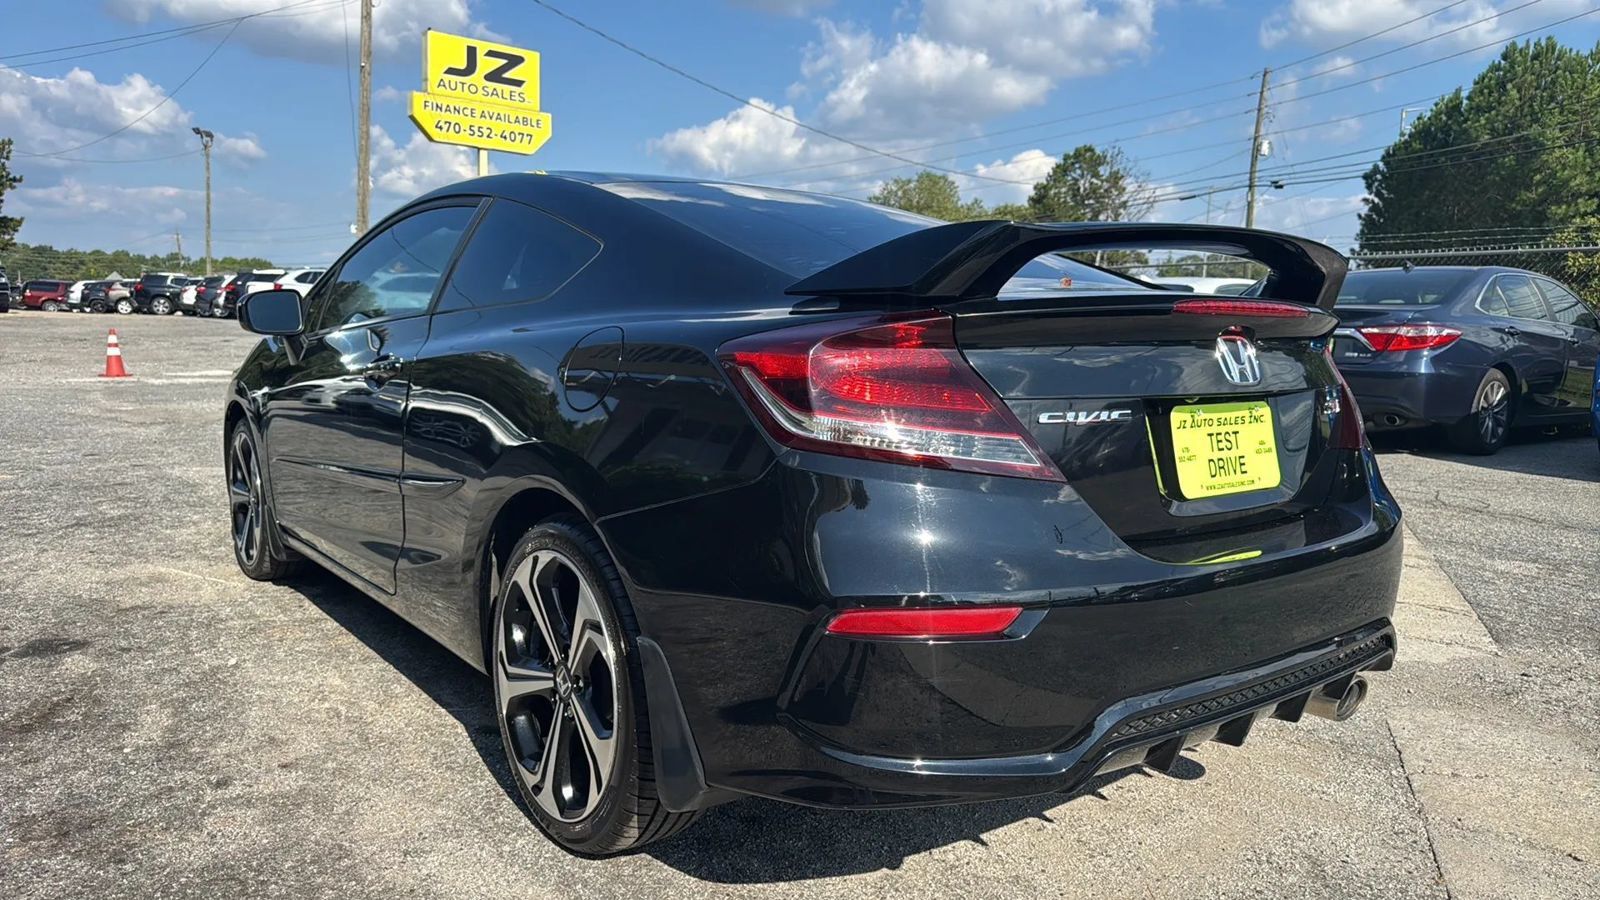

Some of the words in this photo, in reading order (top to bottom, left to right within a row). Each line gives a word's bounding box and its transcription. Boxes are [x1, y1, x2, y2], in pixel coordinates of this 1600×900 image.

[443, 45, 526, 88] JZ
[437, 78, 478, 95] AUTO
[482, 86, 526, 103] SALES
[423, 100, 476, 118] FINANCE
[480, 110, 542, 129] AVAILABLE
[435, 119, 533, 145] 470-552-4077
[1038, 409, 1132, 426] CIVIC
[1177, 420, 1187, 430] JZ
[1190, 417, 1214, 429] AUTO
[1217, 415, 1246, 427] SALES
[1207, 430, 1239, 453] TEST
[1208, 455, 1248, 479] DRIVE
